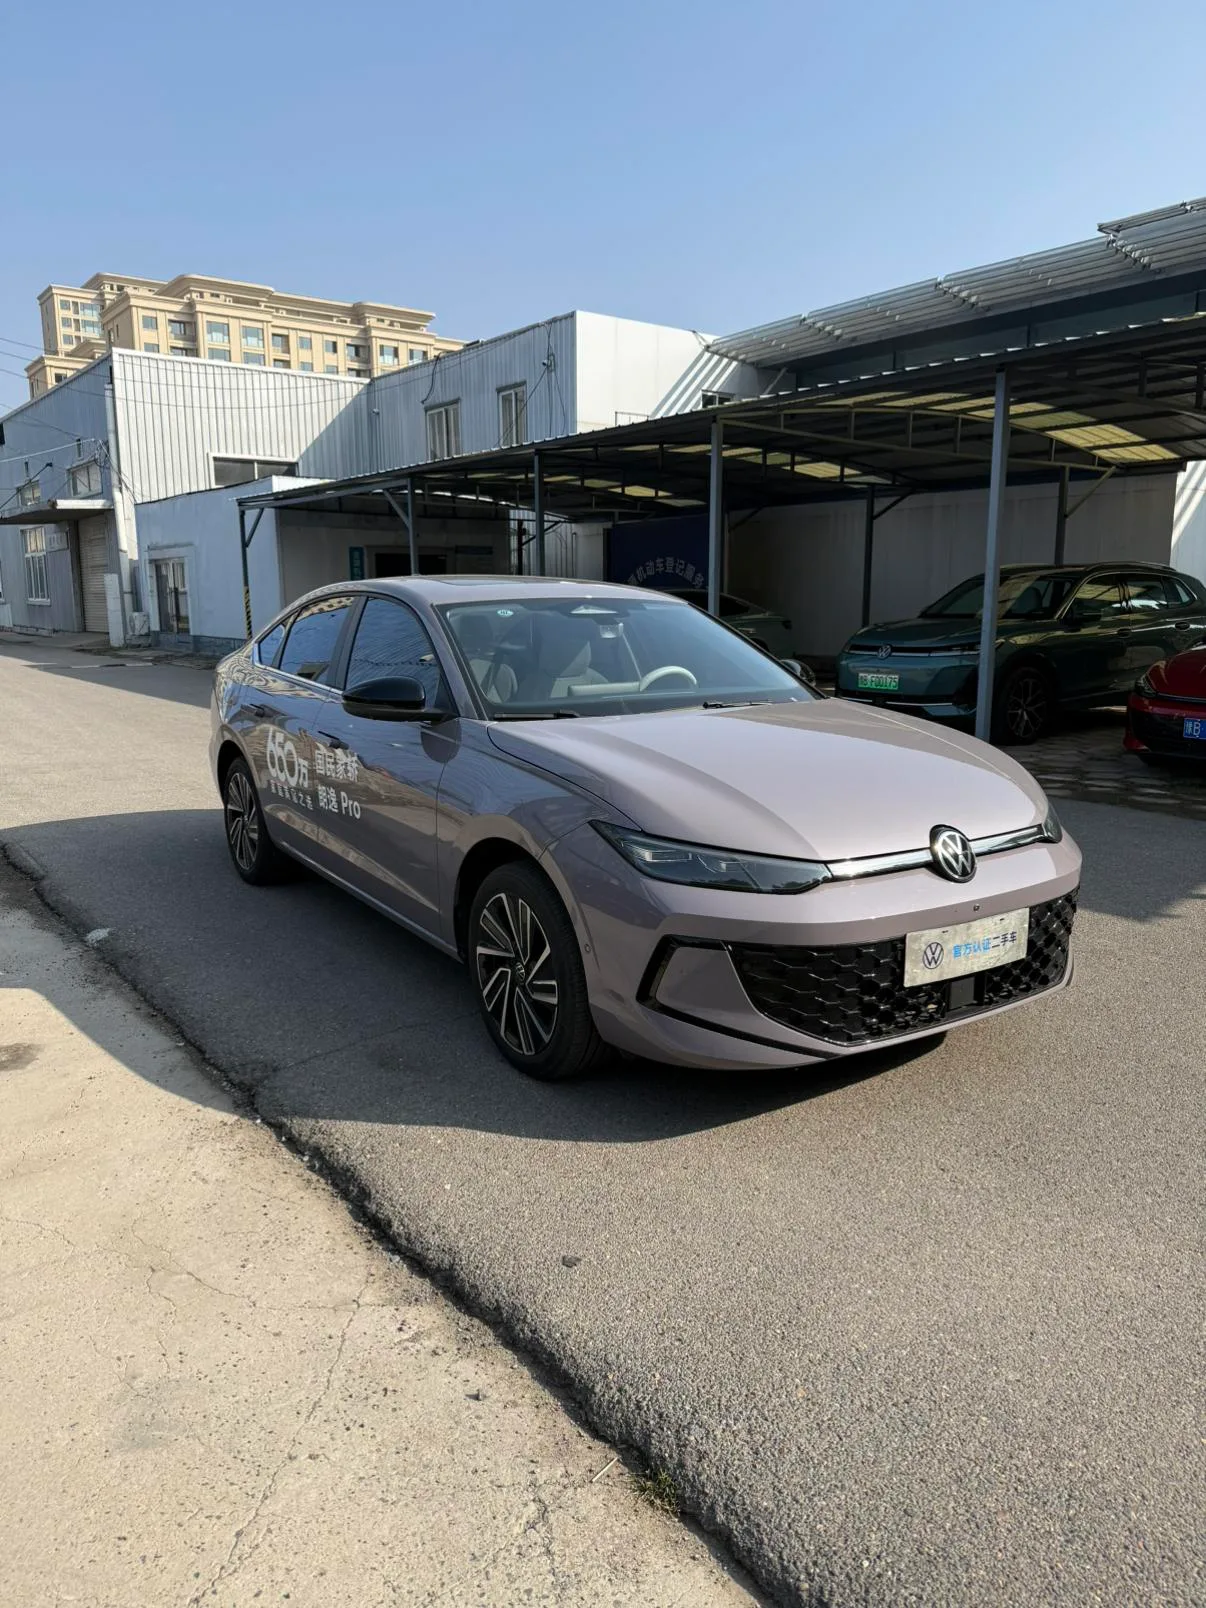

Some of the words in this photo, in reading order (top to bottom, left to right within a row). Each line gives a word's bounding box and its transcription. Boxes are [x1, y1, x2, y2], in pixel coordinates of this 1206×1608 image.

[340, 791, 361, 819] Pro
[952, 931, 1018, 960] 官方认证二手车
